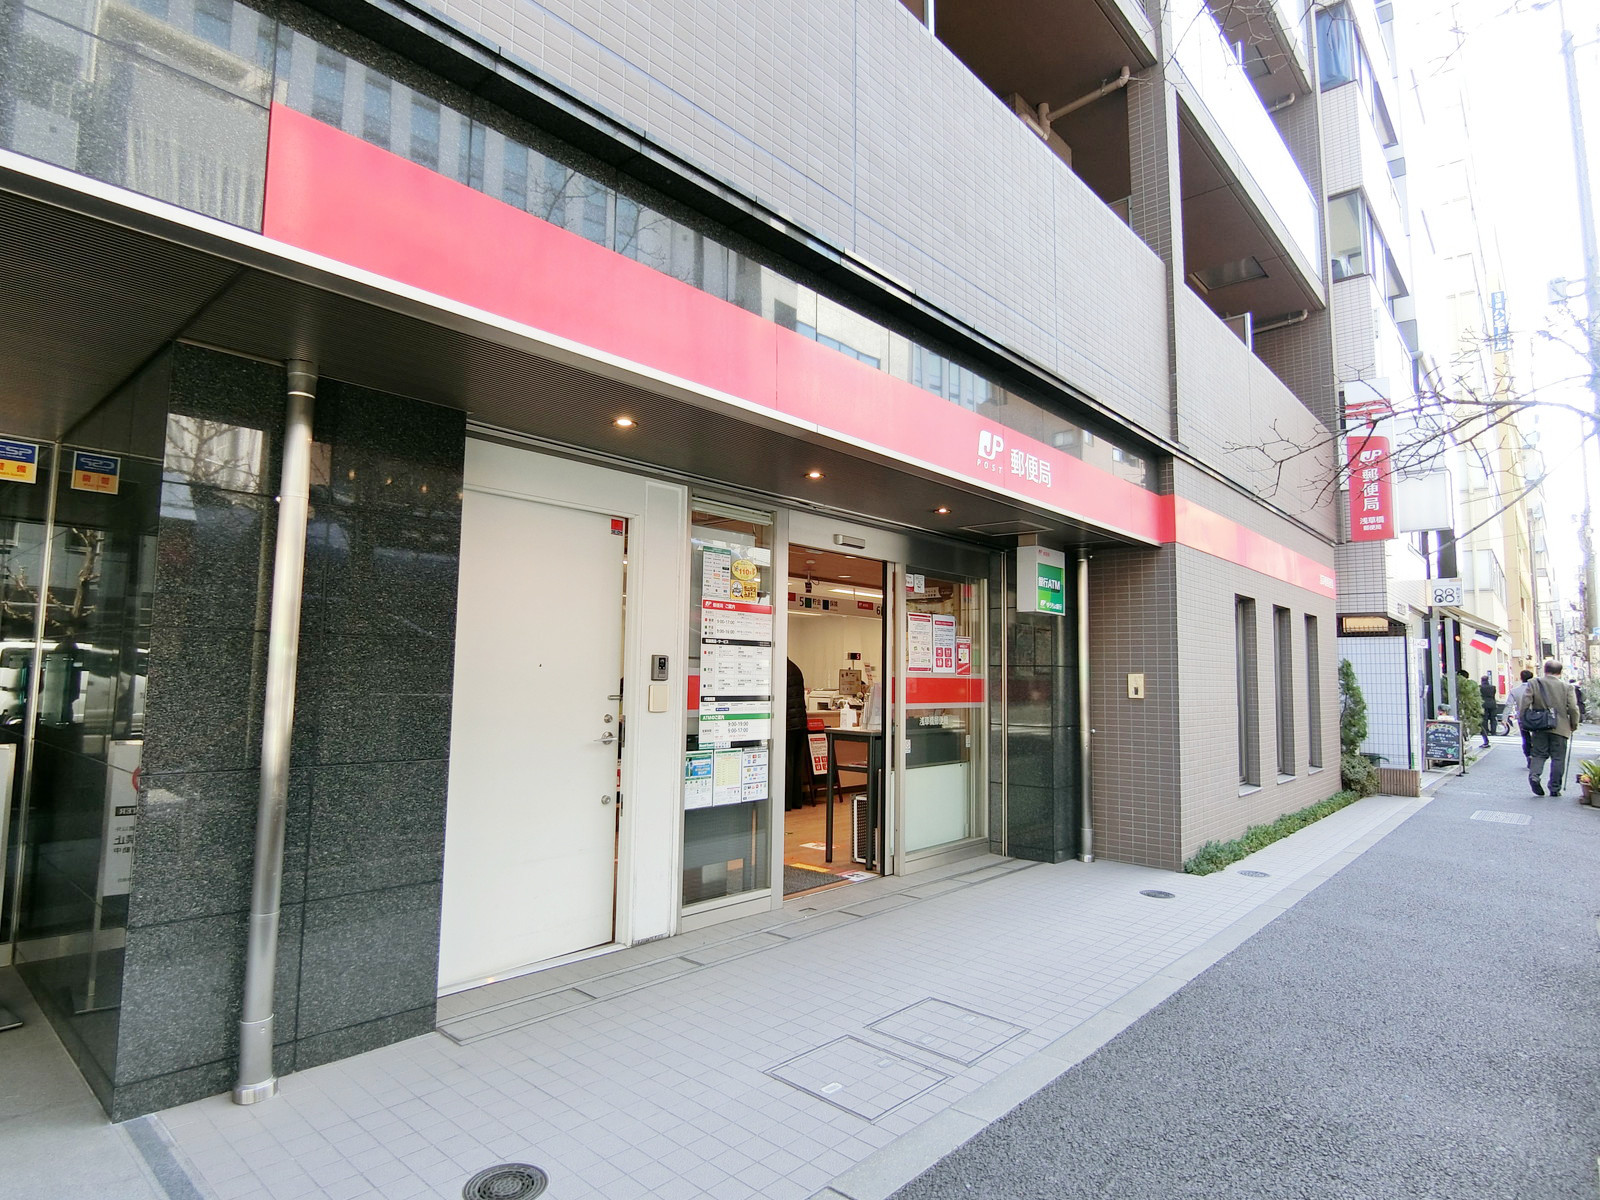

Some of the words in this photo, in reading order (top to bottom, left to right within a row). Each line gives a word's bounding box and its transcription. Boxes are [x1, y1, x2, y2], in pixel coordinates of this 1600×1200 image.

[978, 430, 1004, 460] JP
[1359, 450, 1383, 463] JP
[976, 459, 1004, 475] POST
[1010, 449, 1051, 488] 郵便局
[1362, 468, 1380, 511] 郵便局
[799, 597, 804, 607] 5
